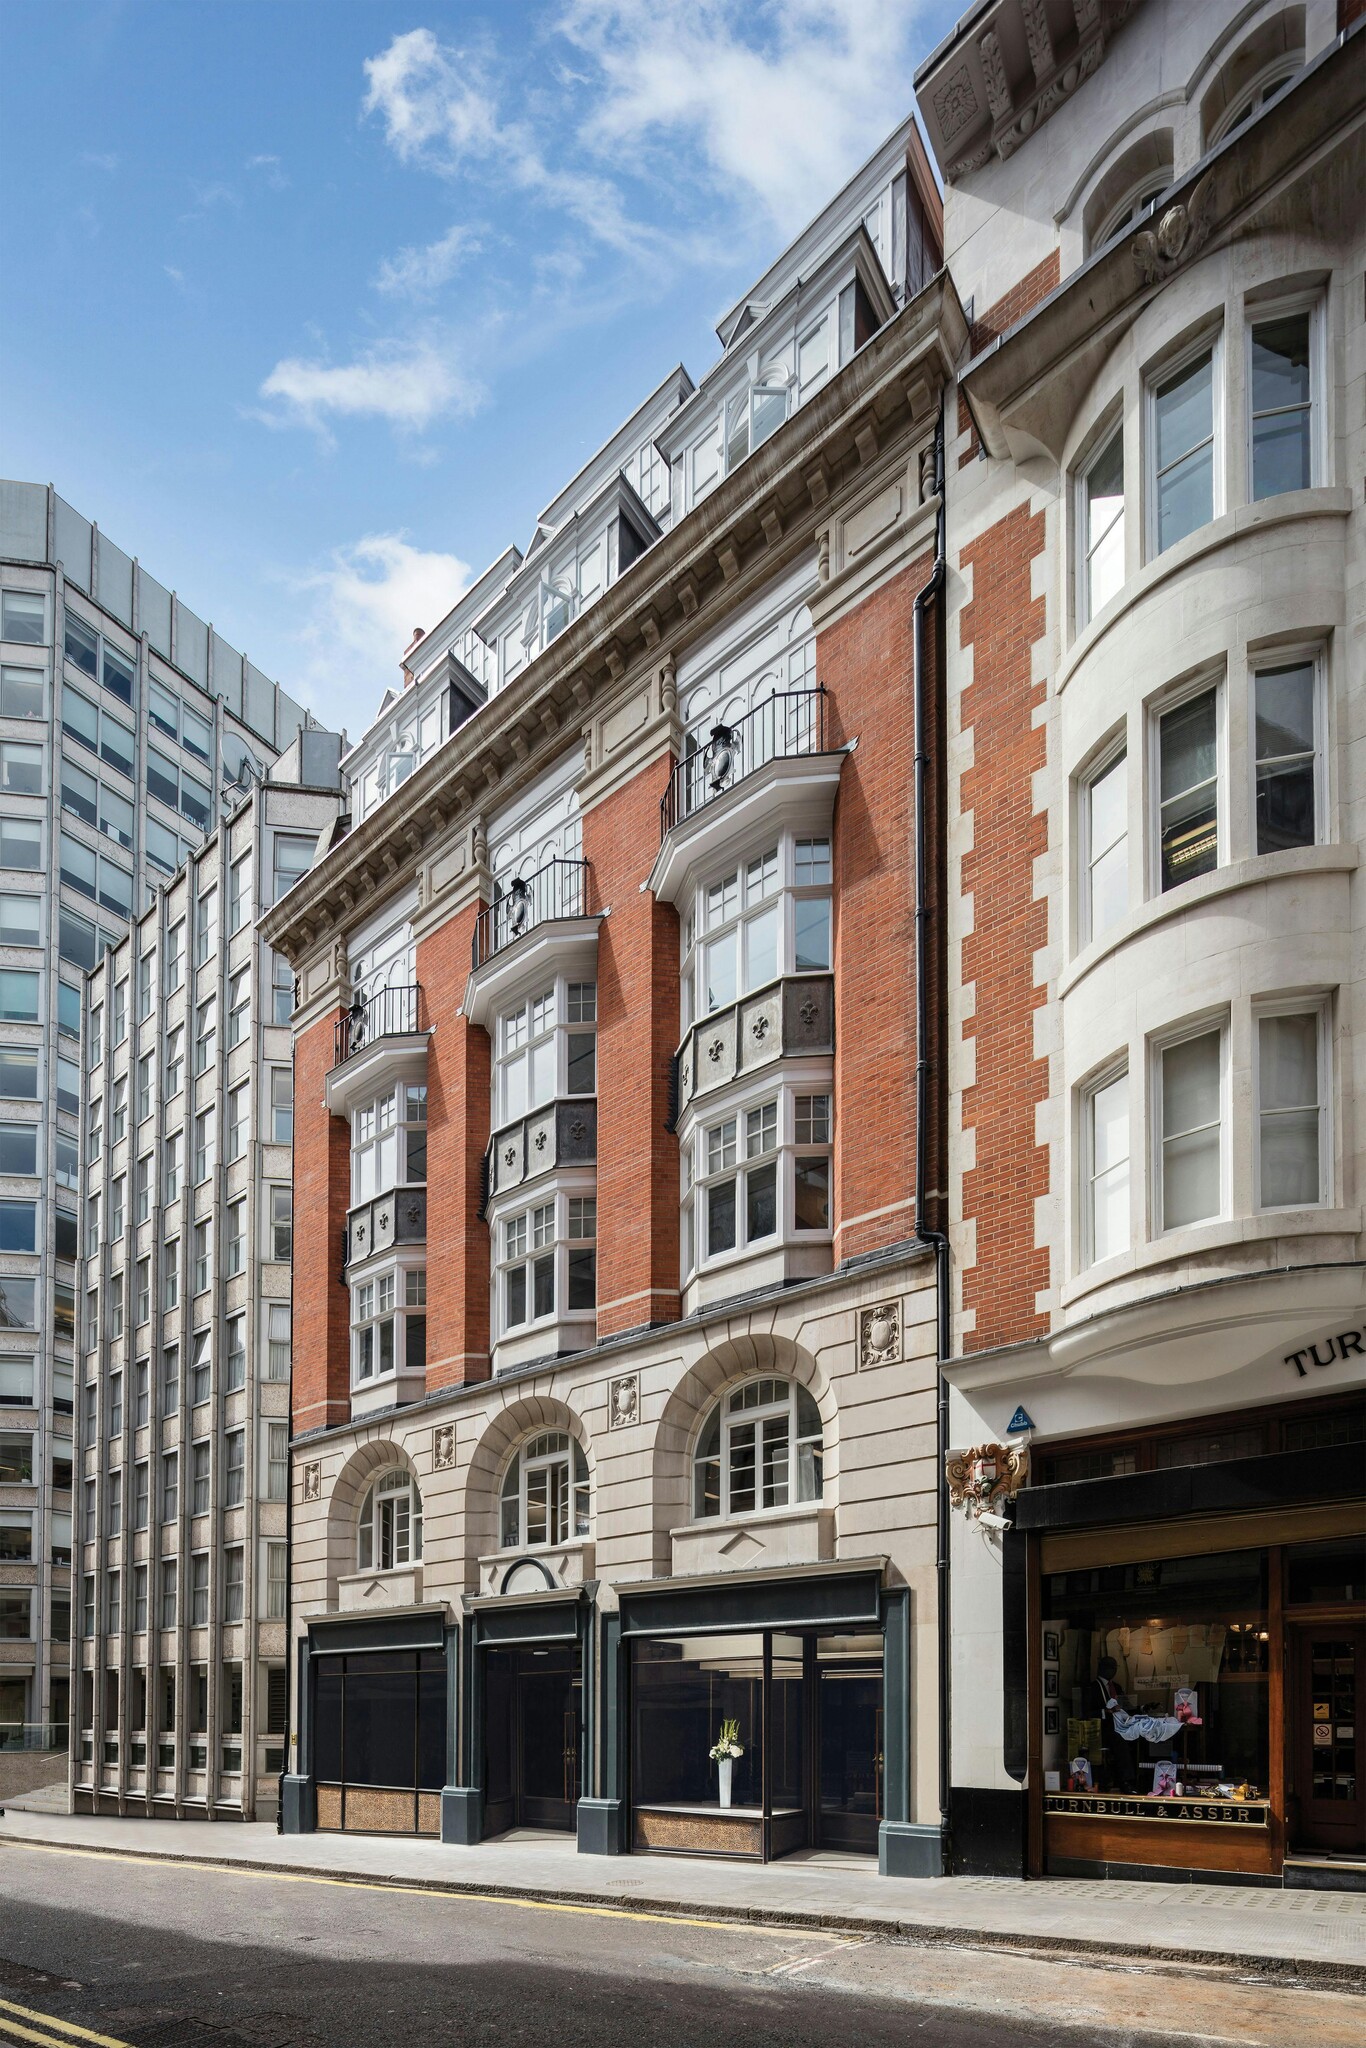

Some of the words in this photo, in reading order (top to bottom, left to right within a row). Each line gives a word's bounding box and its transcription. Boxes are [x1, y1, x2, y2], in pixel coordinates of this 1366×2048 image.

[1284, 1326, 1366, 1377] TUR
[1044, 1799, 1145, 1816] TURNBULL
[1156, 1805, 1169, 1817] &
[1178, 1806, 1251, 1821] ASSER
